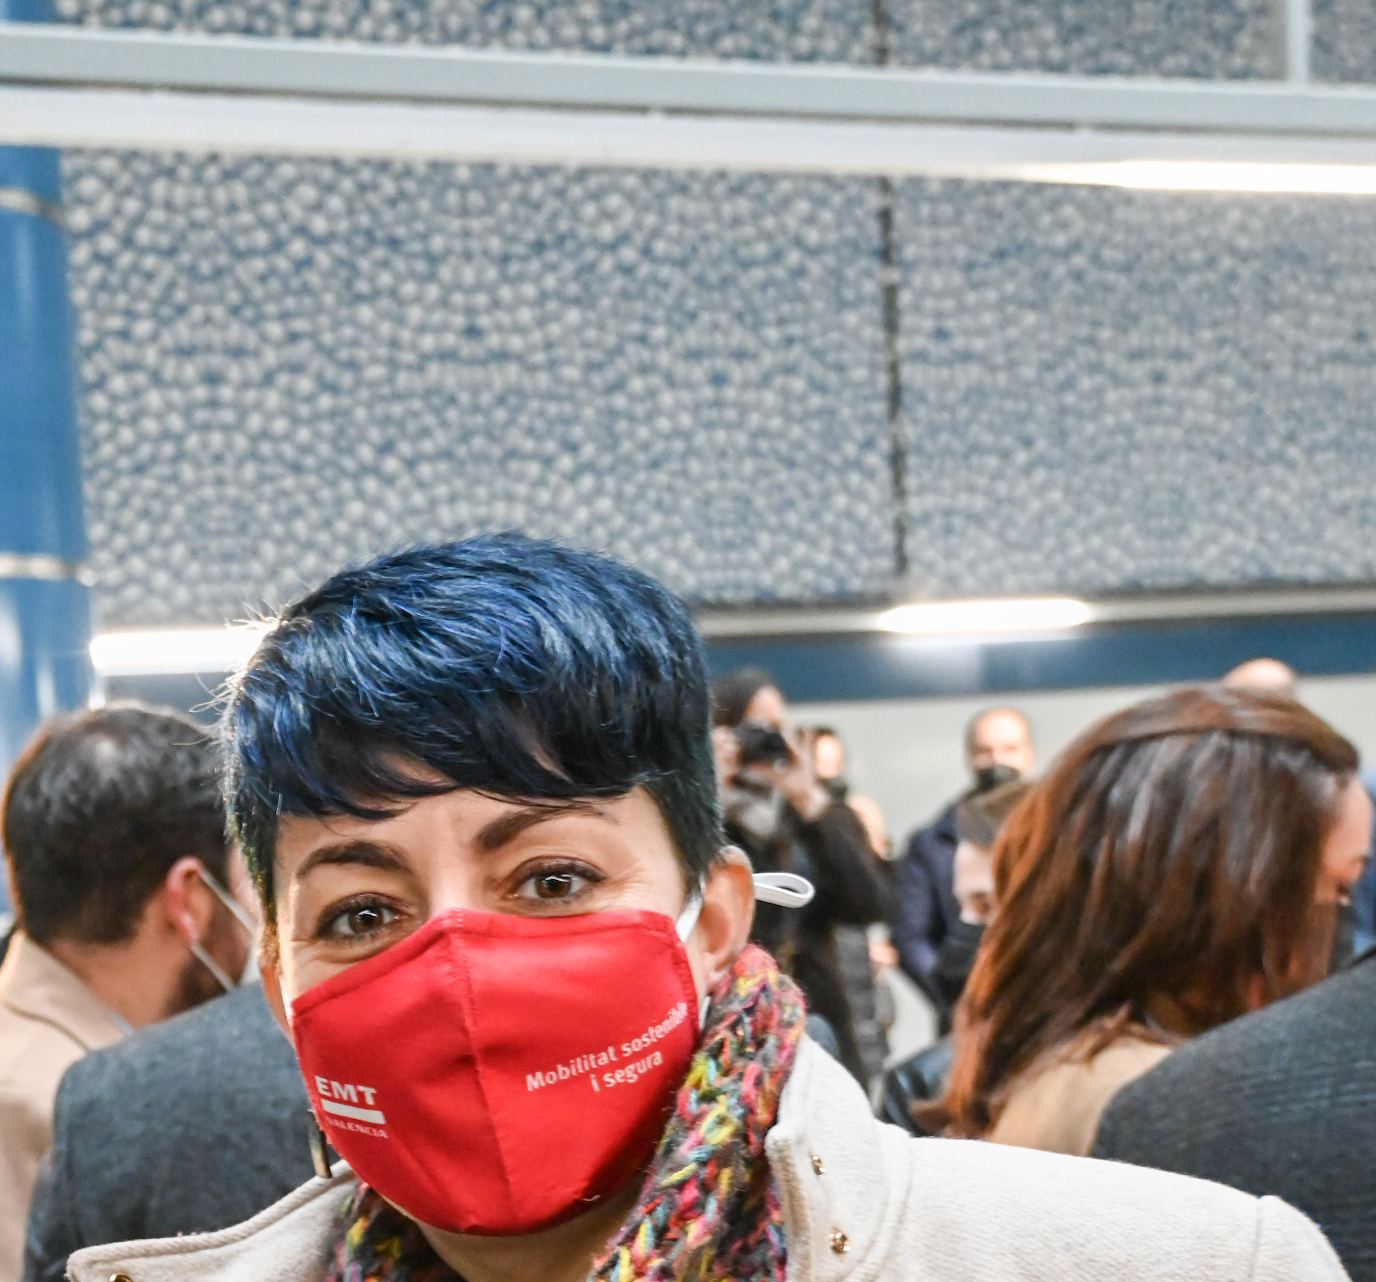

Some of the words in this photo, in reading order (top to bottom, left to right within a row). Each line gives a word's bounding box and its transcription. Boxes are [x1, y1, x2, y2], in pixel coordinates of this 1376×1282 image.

[525, 1046, 619, 1092] Mobilitat
[589, 1073, 601, 1092] i
[602, 1051, 664, 1088] segura
[314, 1075, 377, 1106] EMT
